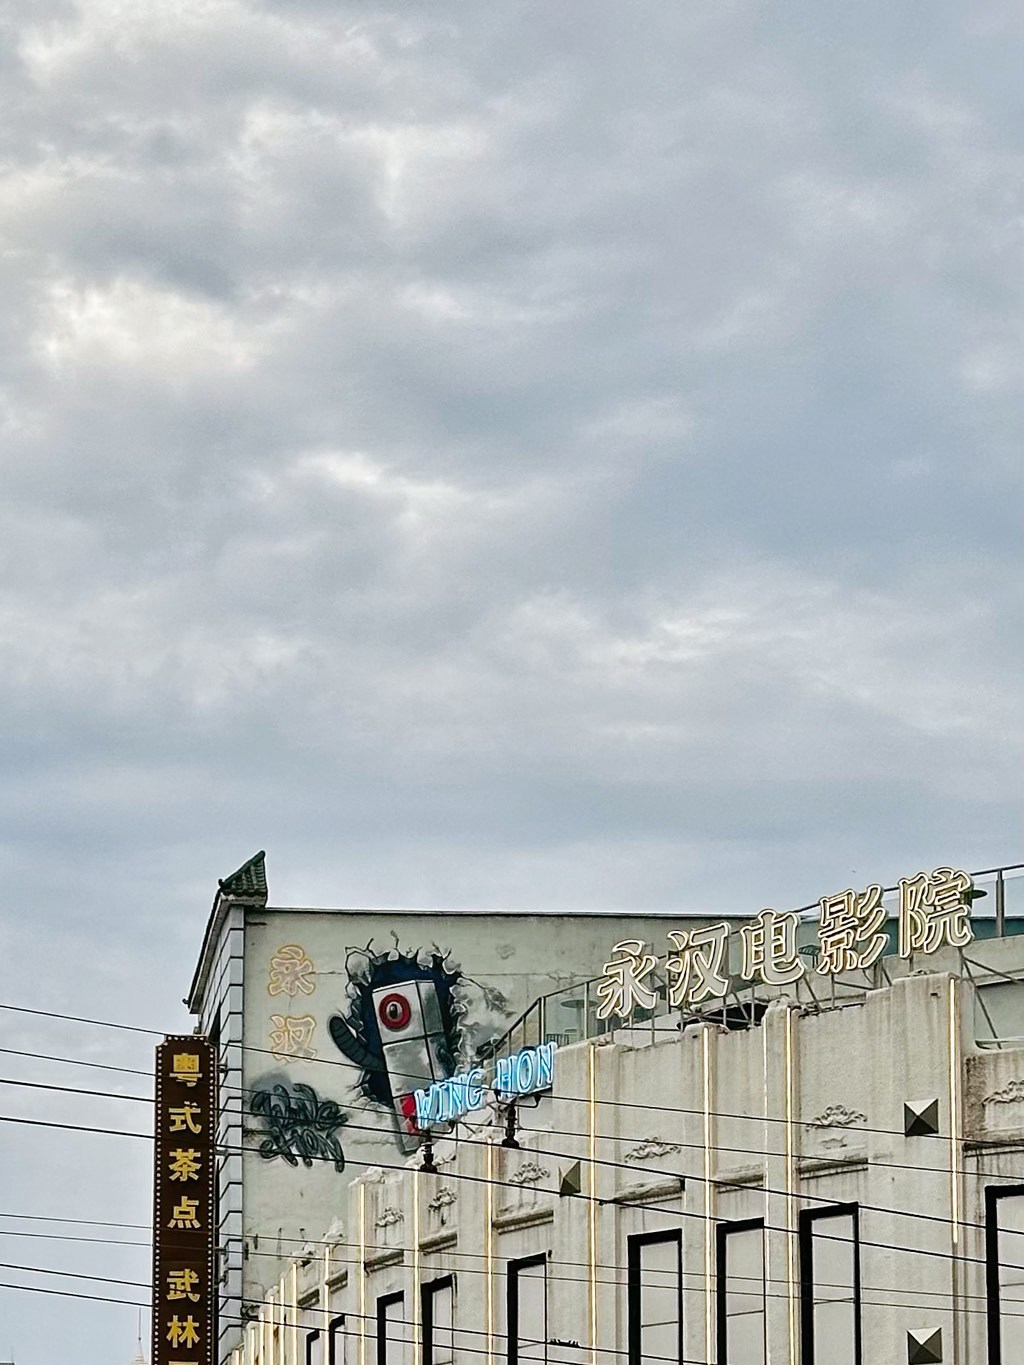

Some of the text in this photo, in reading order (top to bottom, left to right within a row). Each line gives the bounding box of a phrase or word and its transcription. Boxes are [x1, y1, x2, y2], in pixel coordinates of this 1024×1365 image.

[596, 866, 976, 1020] 永汉电影院
[167, 1052, 203, 1229] 粤式茶点
[414, 1067, 486, 1132] WING
[494, 1042, 559, 1099] HON
